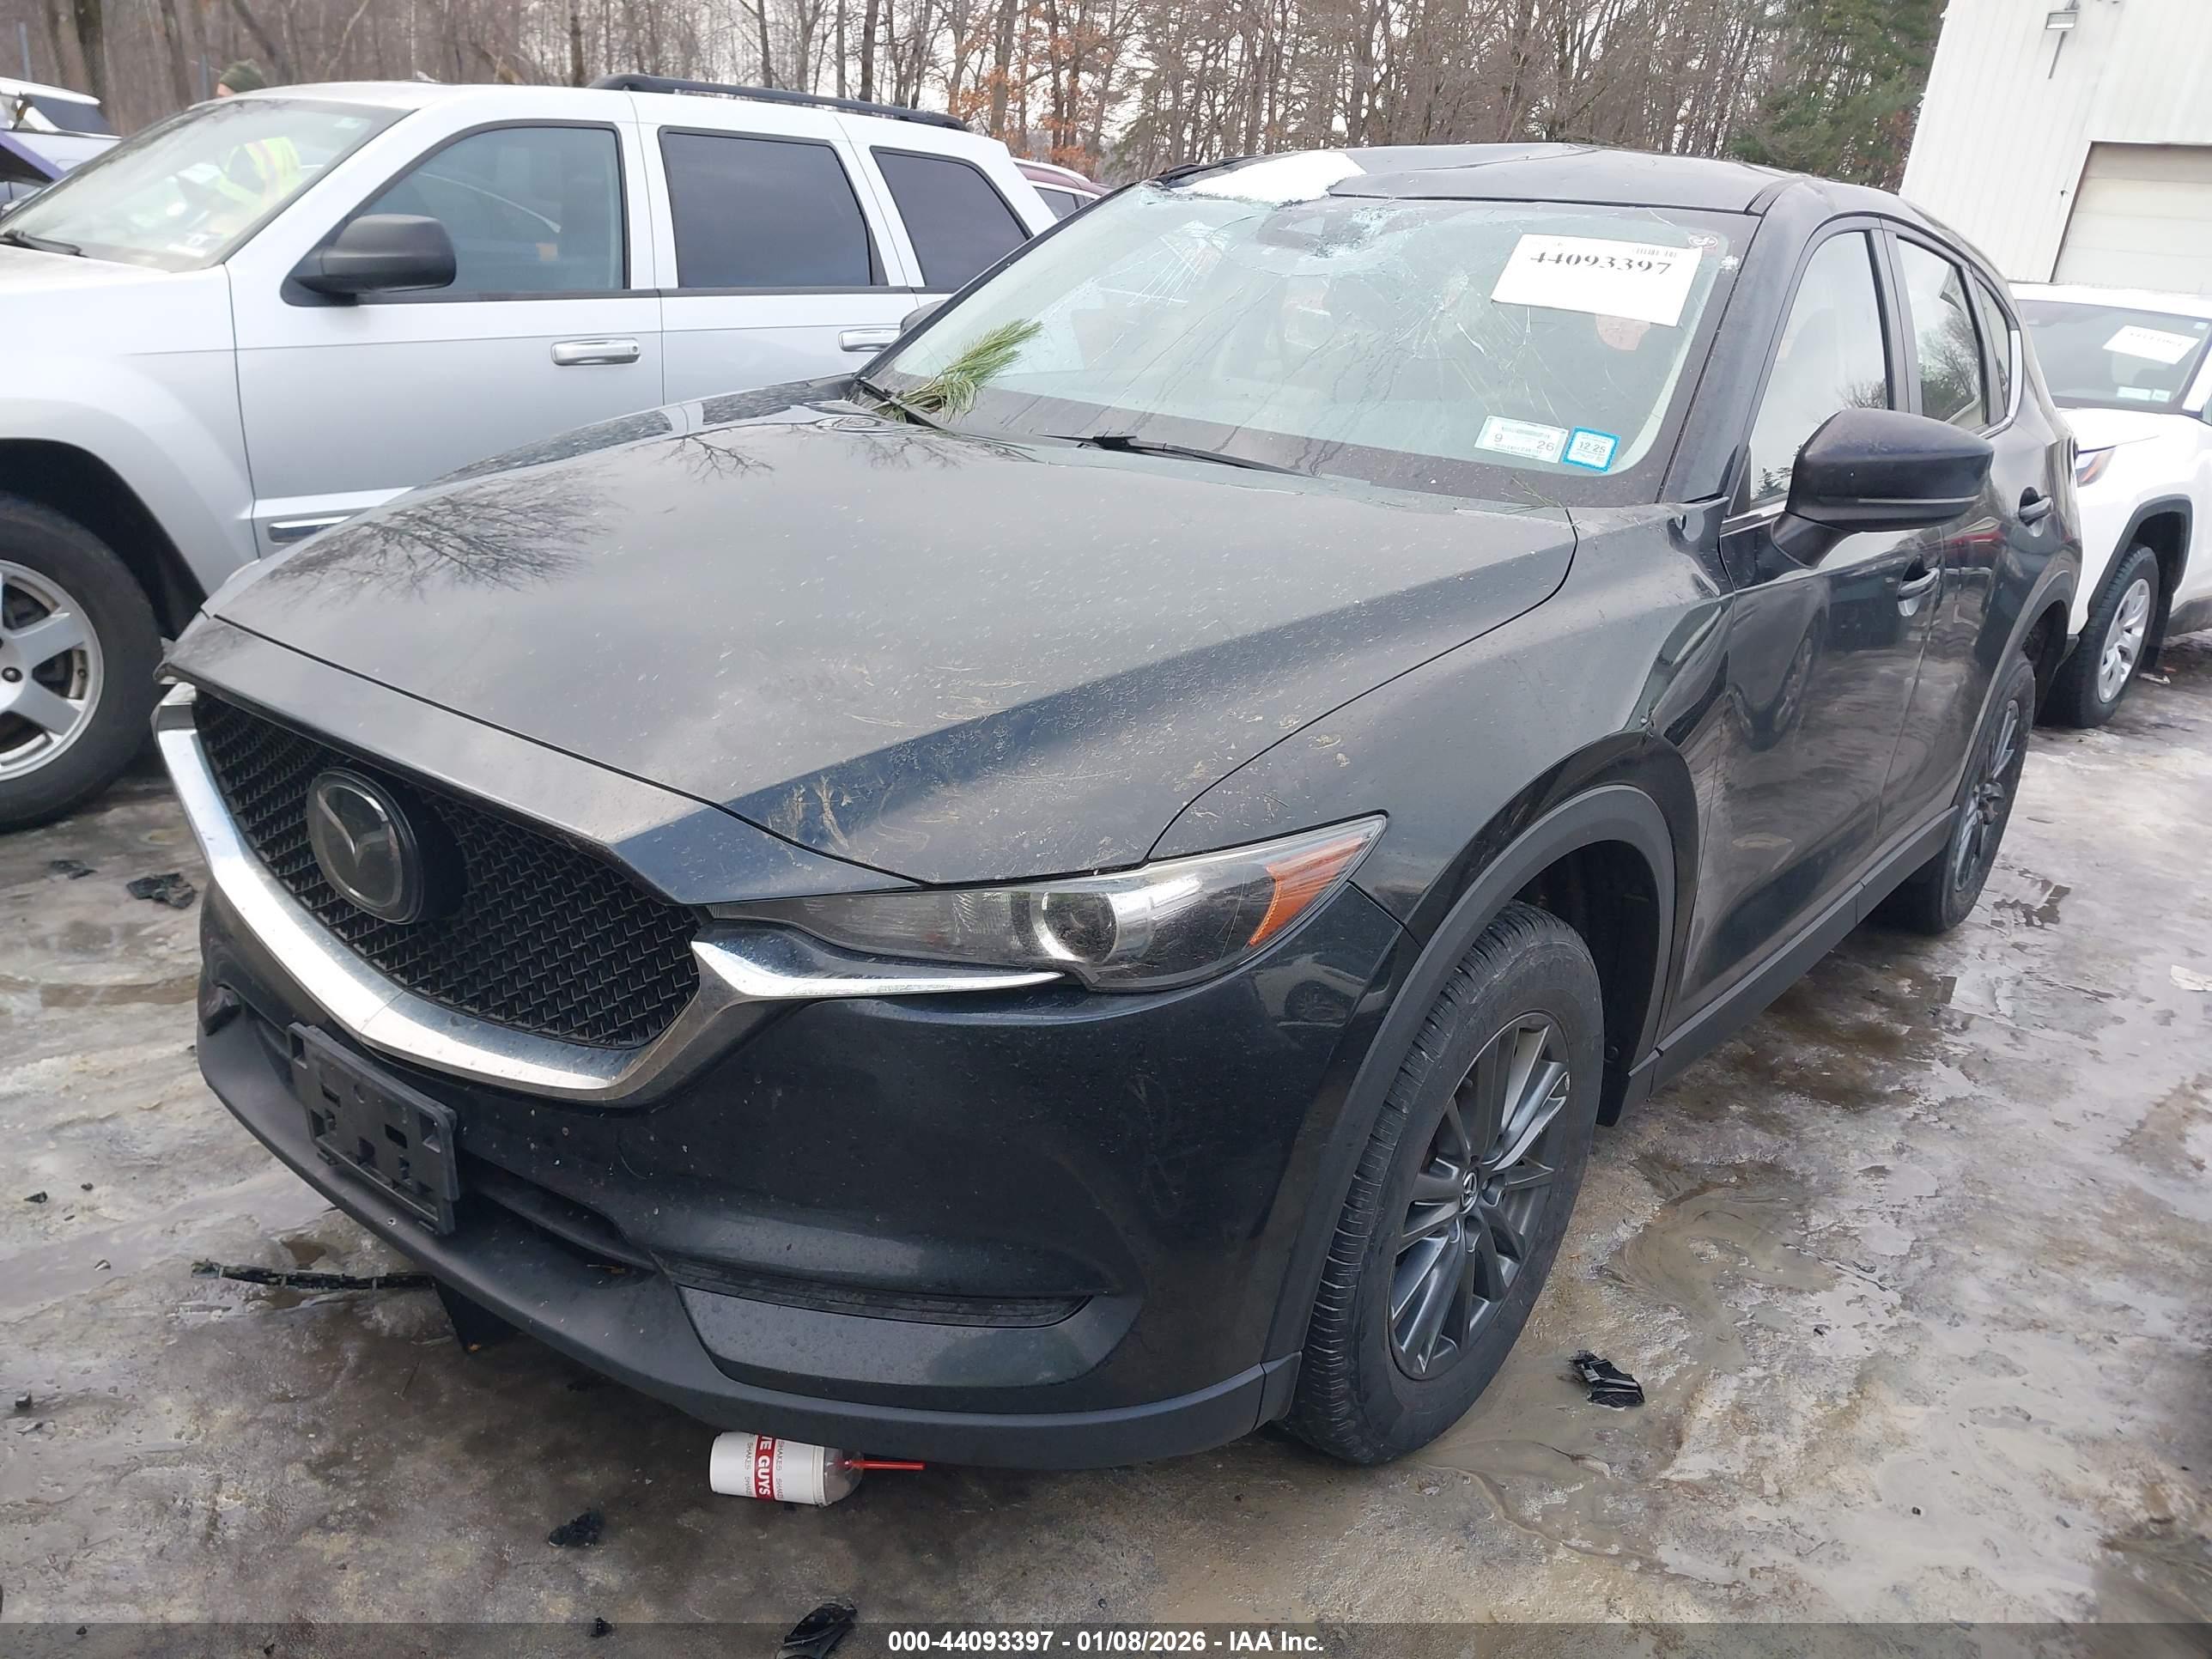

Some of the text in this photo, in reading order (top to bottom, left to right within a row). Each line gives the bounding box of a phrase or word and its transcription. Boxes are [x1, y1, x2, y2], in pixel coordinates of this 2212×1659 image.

[1529, 251, 1672, 275] 44093397
[1493, 433, 1504, 442] 9
[1537, 440, 1555, 452] 26
[1579, 441, 1607, 453] 12 25
[775, 1441, 785, 1471] SHAKES
[757, 1455, 771, 1495] GUYS
